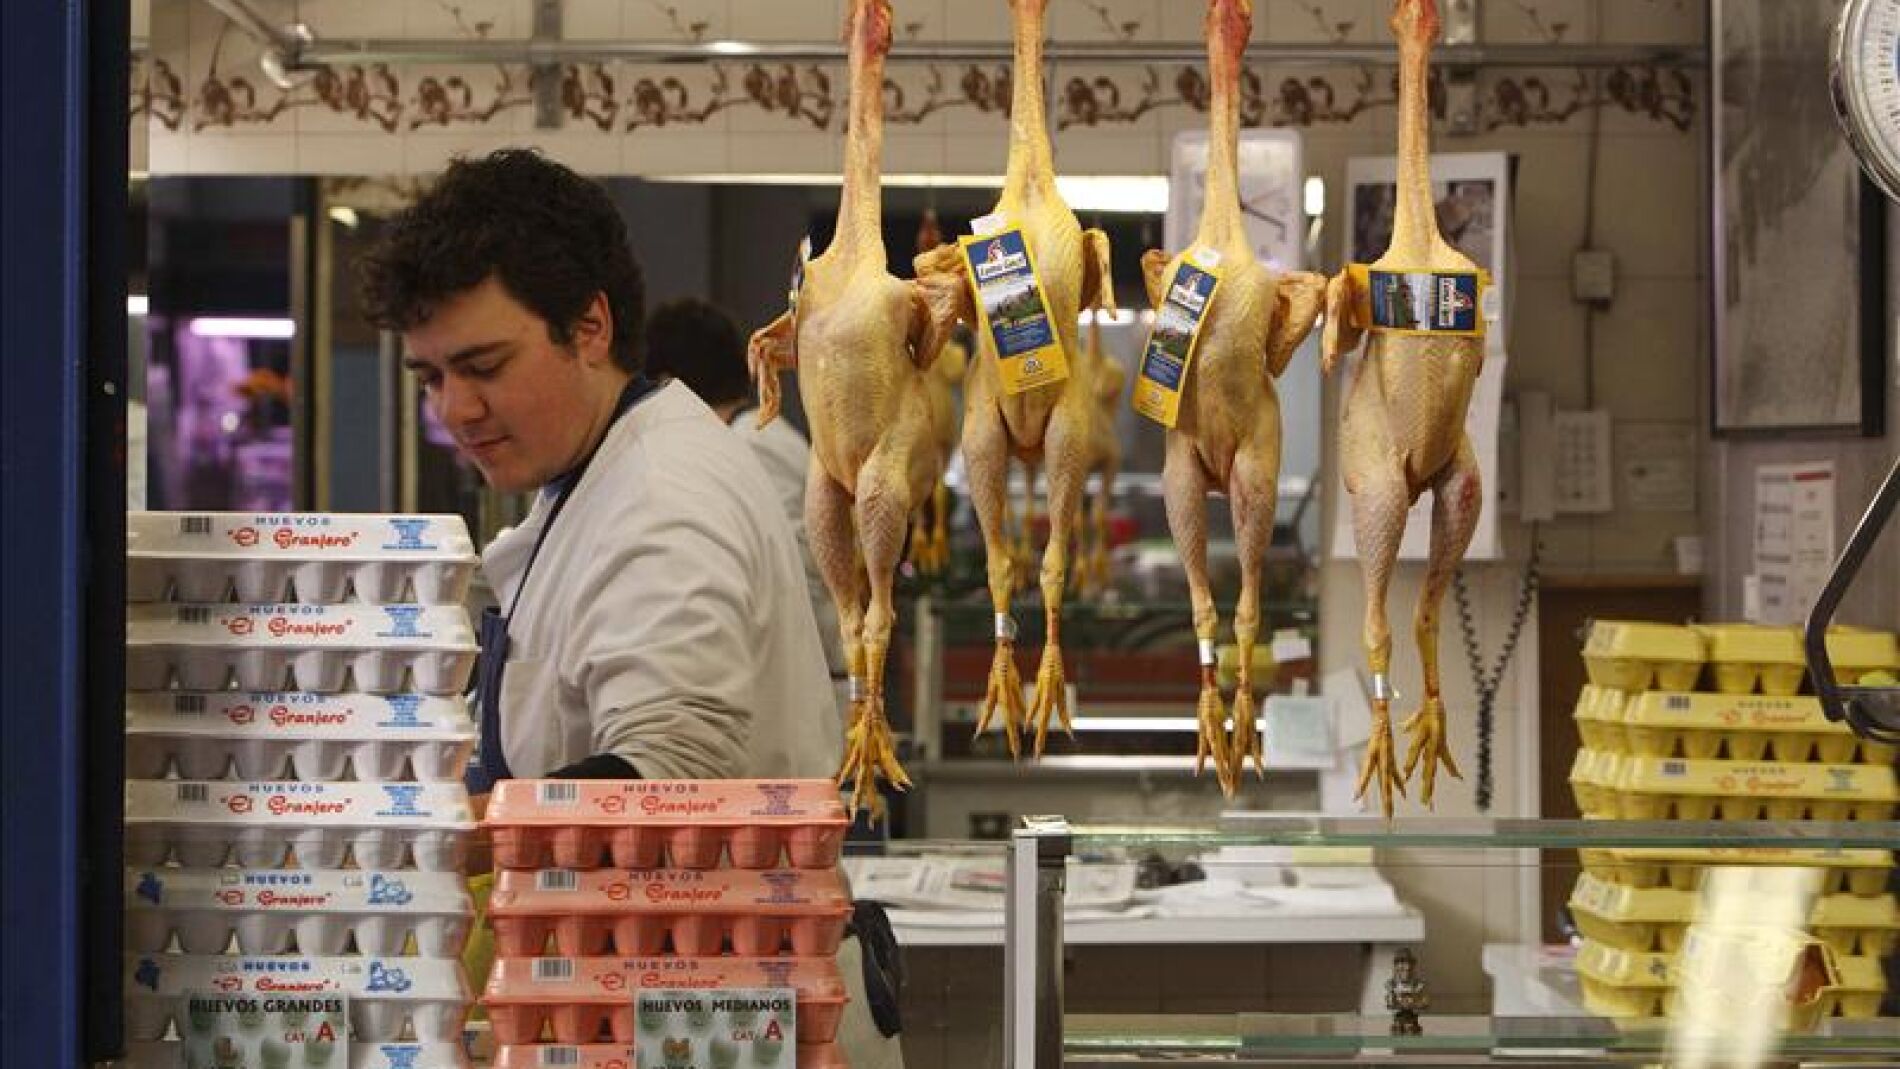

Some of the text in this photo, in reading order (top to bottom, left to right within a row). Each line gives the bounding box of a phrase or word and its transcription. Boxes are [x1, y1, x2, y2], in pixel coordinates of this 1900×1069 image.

[246, 873, 312, 884] HUEVOS
[243, 961, 310, 972] HUEVOS
[190, 1000, 343, 1012] HUEVOS GRANDES
[643, 1000, 790, 1012] HUEVOS MEDIANOS
[316, 1021, 336, 1042] A
[765, 1019, 784, 1042] A
